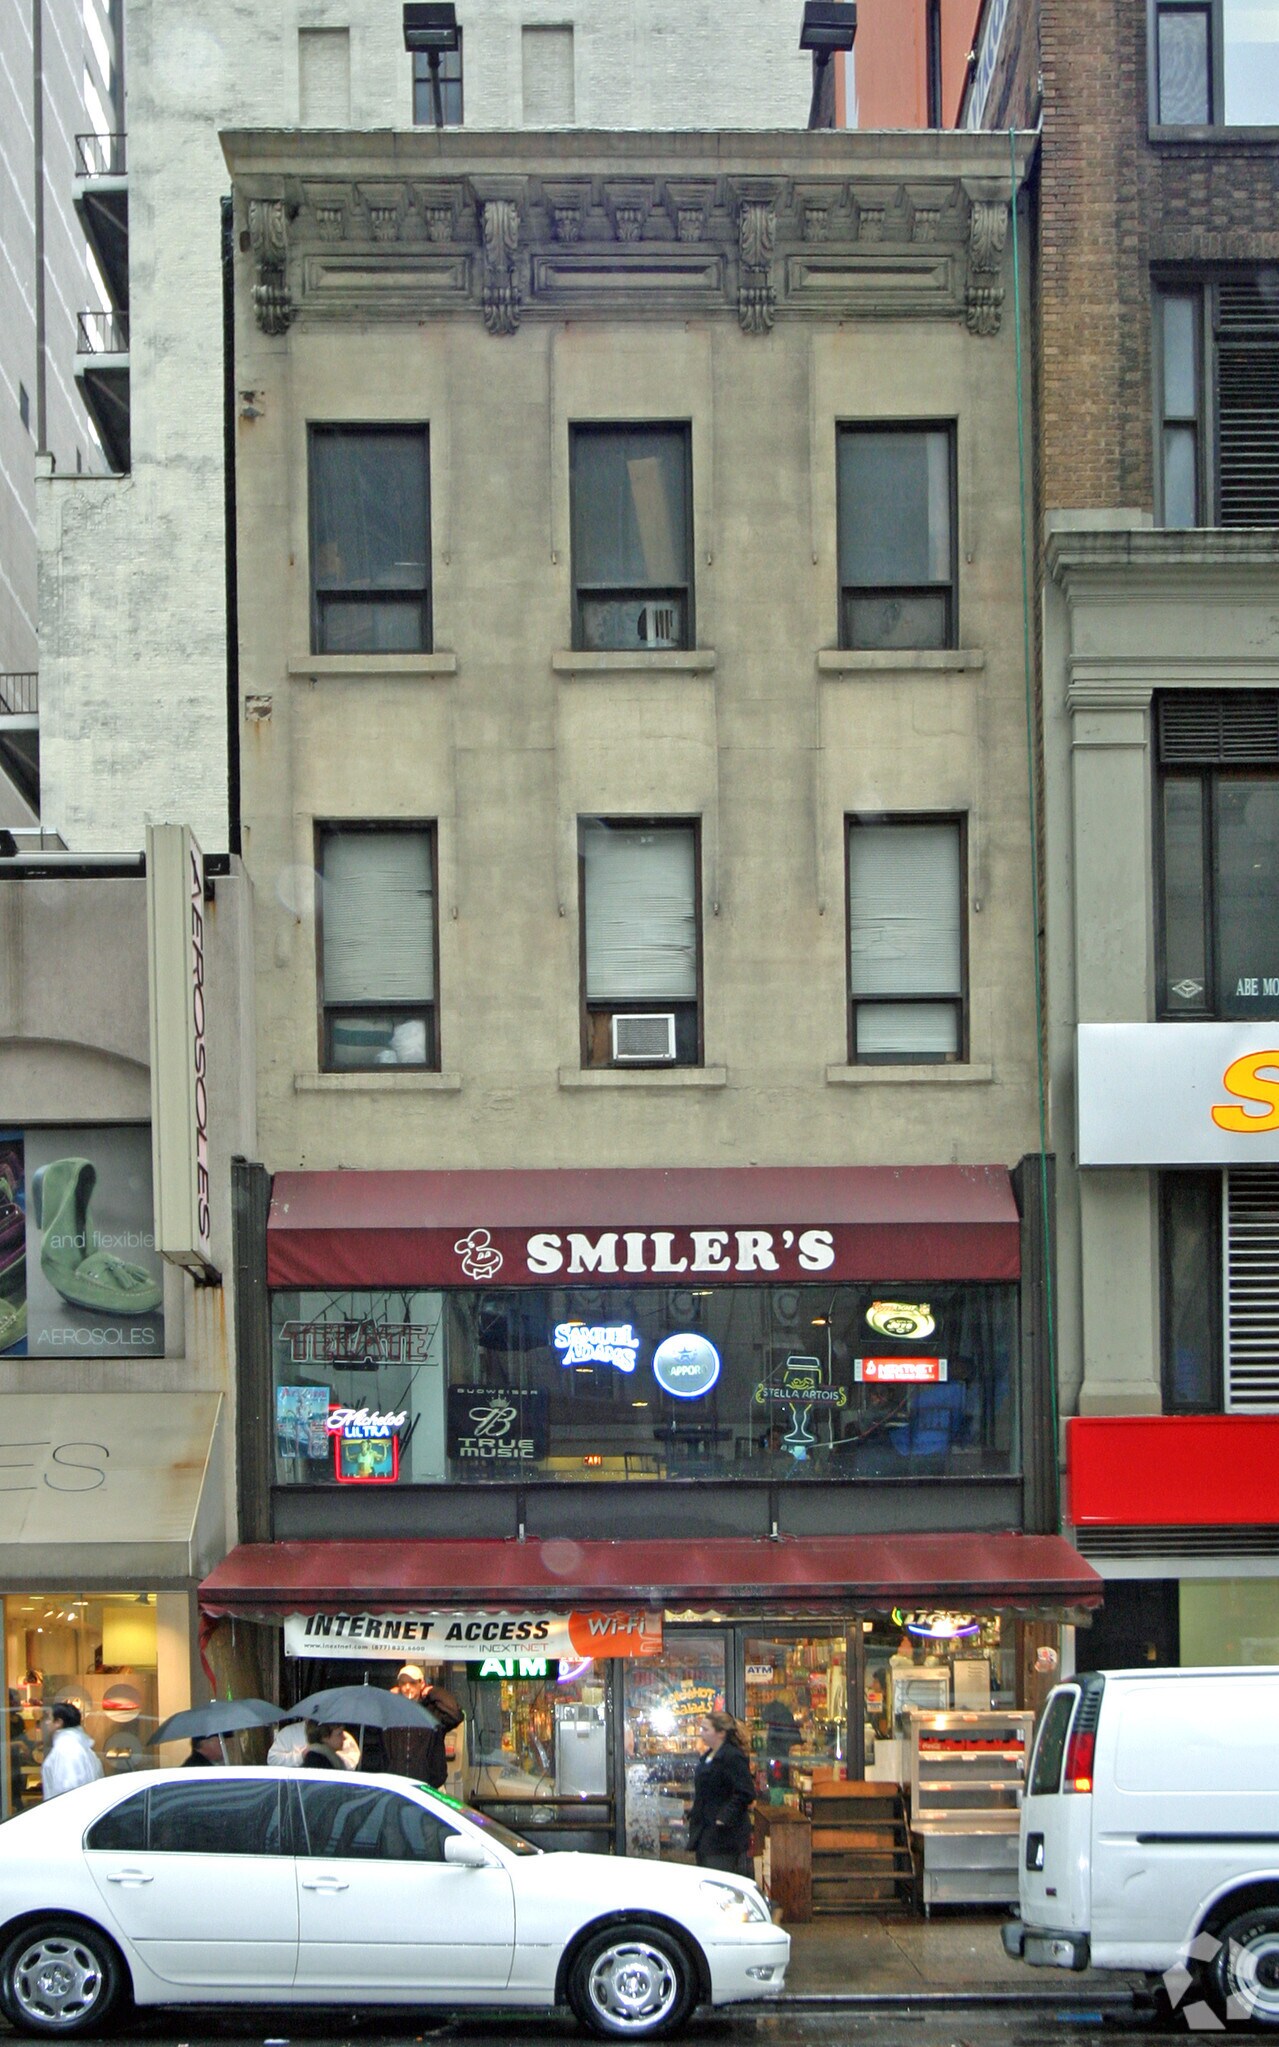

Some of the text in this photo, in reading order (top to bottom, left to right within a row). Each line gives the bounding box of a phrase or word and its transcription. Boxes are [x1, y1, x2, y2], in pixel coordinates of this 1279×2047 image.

[1236, 978, 1258, 996] ABE
[190, 850, 211, 1240] AEROSOLES
[1211, 1050, 1279, 1133] S
[50, 1231, 154, 1248] and flexible
[527, 1230, 835, 1274] SMILER'S
[37, 1327, 155, 1345] AEROSOLES
[763, 1388, 839, 1400] STELLA ARTOIS
[327, 1408, 407, 1429] Michelob
[345, 1426, 389, 1438] ULTRA
[458, 1438, 534, 1449] TRUE
[304, 1615, 550, 1641] INTERNET ACCESS
[588, 1616, 645, 1636] Wi-Fi
[479, 1643, 549, 1653] INEXTNET
[480, 1657, 546, 1676] ATM
[747, 1666, 773, 1674] ATM
